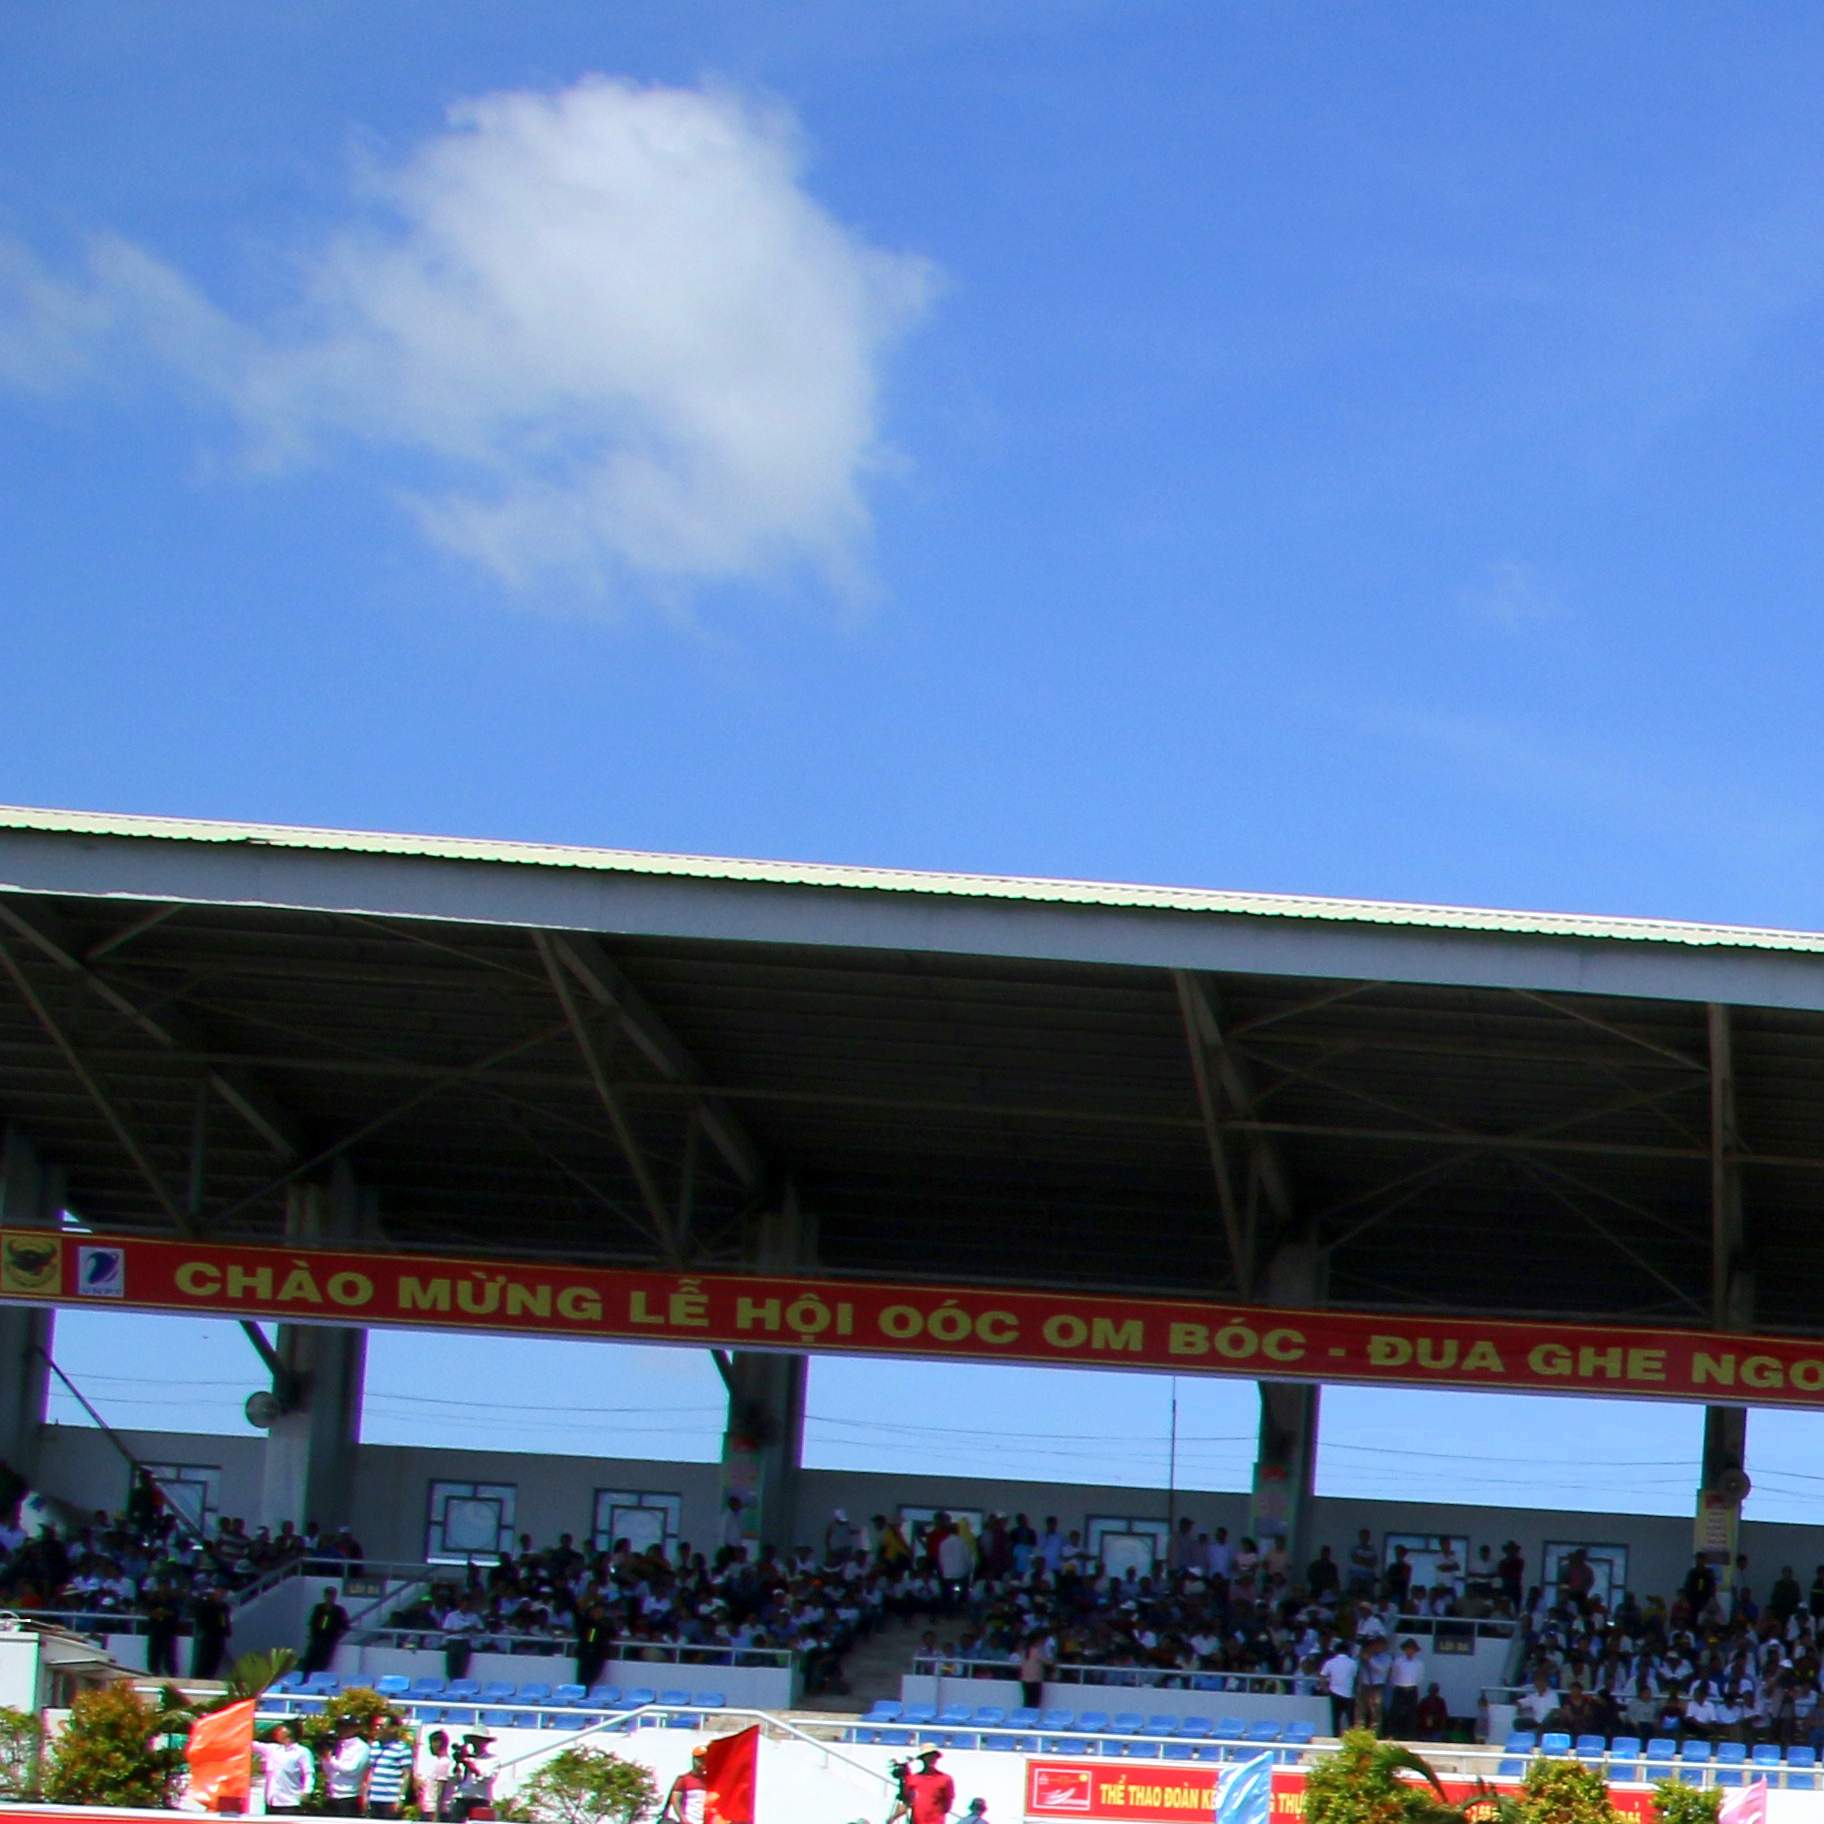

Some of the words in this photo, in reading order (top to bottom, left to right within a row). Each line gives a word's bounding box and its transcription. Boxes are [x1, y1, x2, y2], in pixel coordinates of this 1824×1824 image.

[175, 1261, 374, 1306] CHÀO
[400, 1271, 603, 1321] MỪNG
[629, 1279, 710, 1328] LỄ
[736, 1292, 853, 1343] HỘI
[878, 1301, 1020, 1344] OÓC
[1042, 1314, 1144, 1353] OM
[1168, 1317, 1307, 1362] BÓC
[1367, 1334, 1506, 1372] ĐUA
[1528, 1343, 1668, 1381] GHE
[1100, 1774, 1125, 1805] THỂ
[1128, 1786, 1161, 1807] THAO
[1164, 1782, 1198, 1809] ĐOÀN
